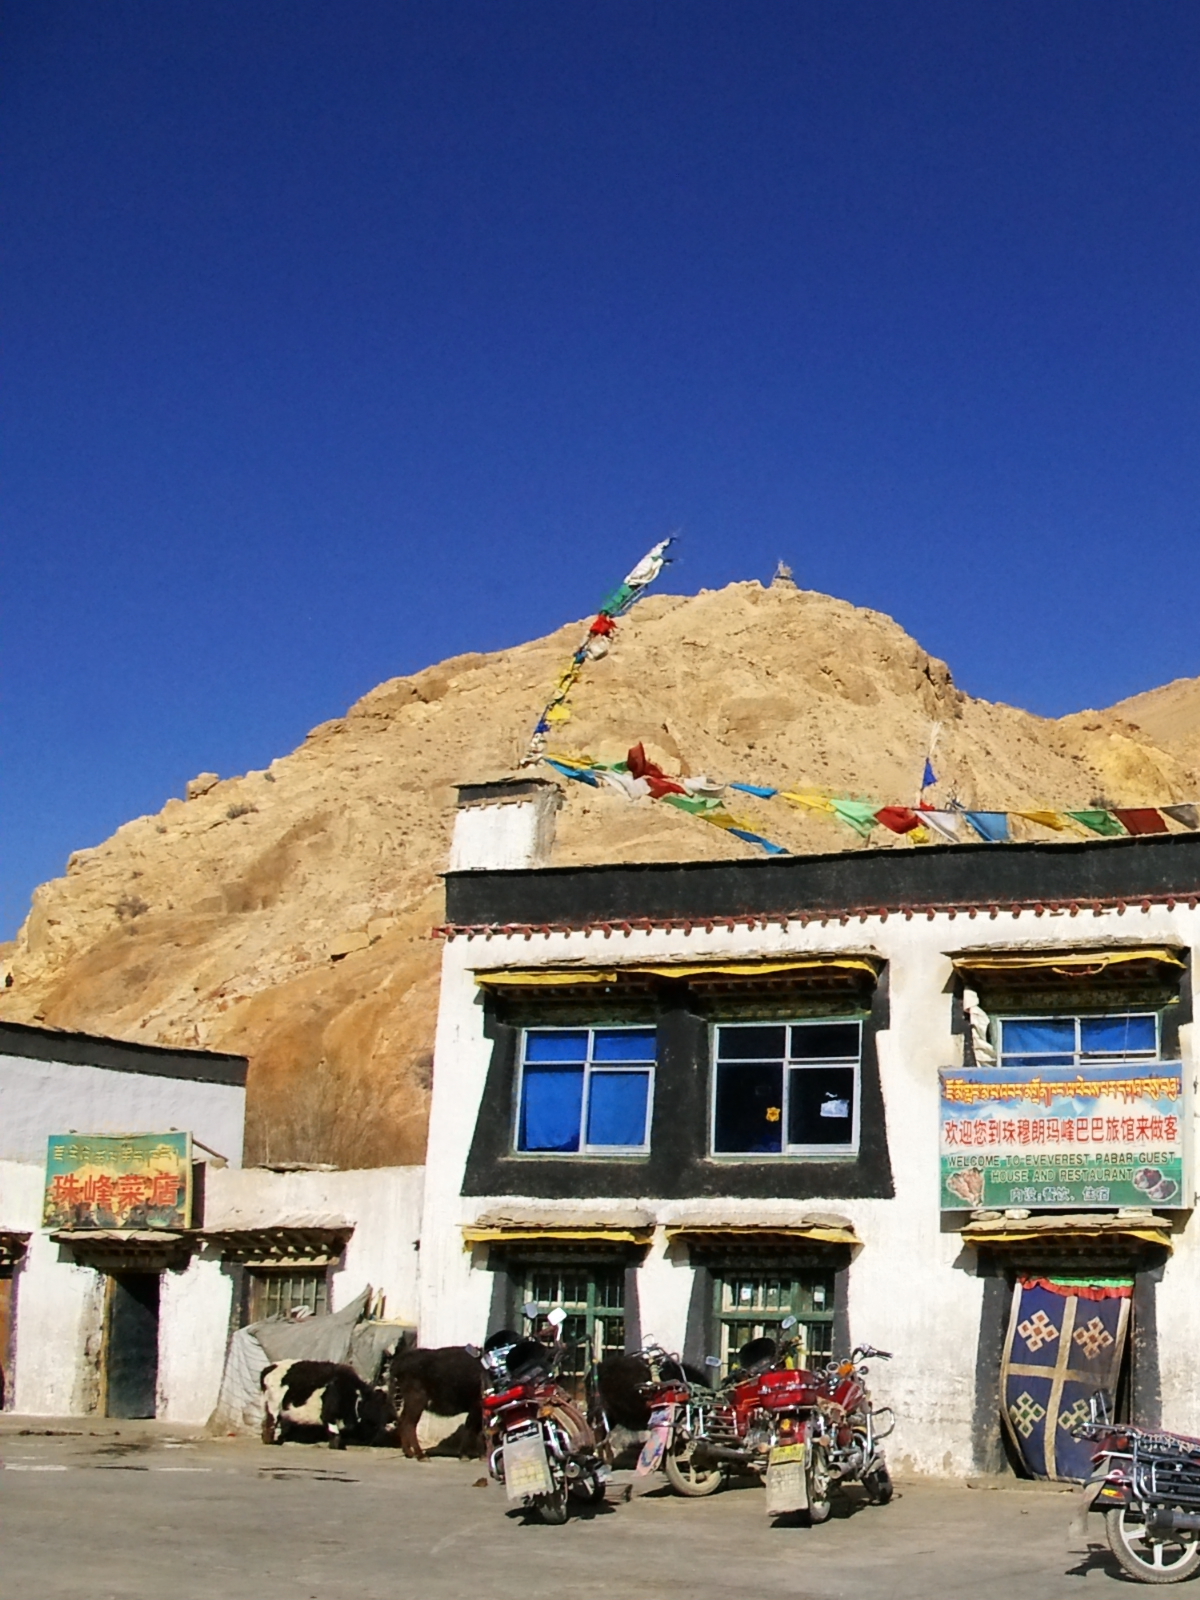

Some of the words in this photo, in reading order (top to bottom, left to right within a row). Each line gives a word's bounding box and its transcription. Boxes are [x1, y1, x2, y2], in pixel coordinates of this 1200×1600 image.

[945, 1115, 1178, 1145] 欢迎您到珠穆朗玛峰巴巴旅馆来做客
[948, 1155, 1000, 1167] WELCOME
[1006, 1154, 1020, 1166] TO
[1025, 1153, 1090, 1165] EVEVEREST
[1095, 1152, 1133, 1164] PABAR
[1138, 1151, 1175, 1163] GUEST
[992, 1169, 1028, 1182] HOUSE
[1034, 1169, 1055, 1181] AND
[1060, 1168, 1133, 1180] RESTAURANT
[52, 1172, 180, 1206] 珠峰菜店
